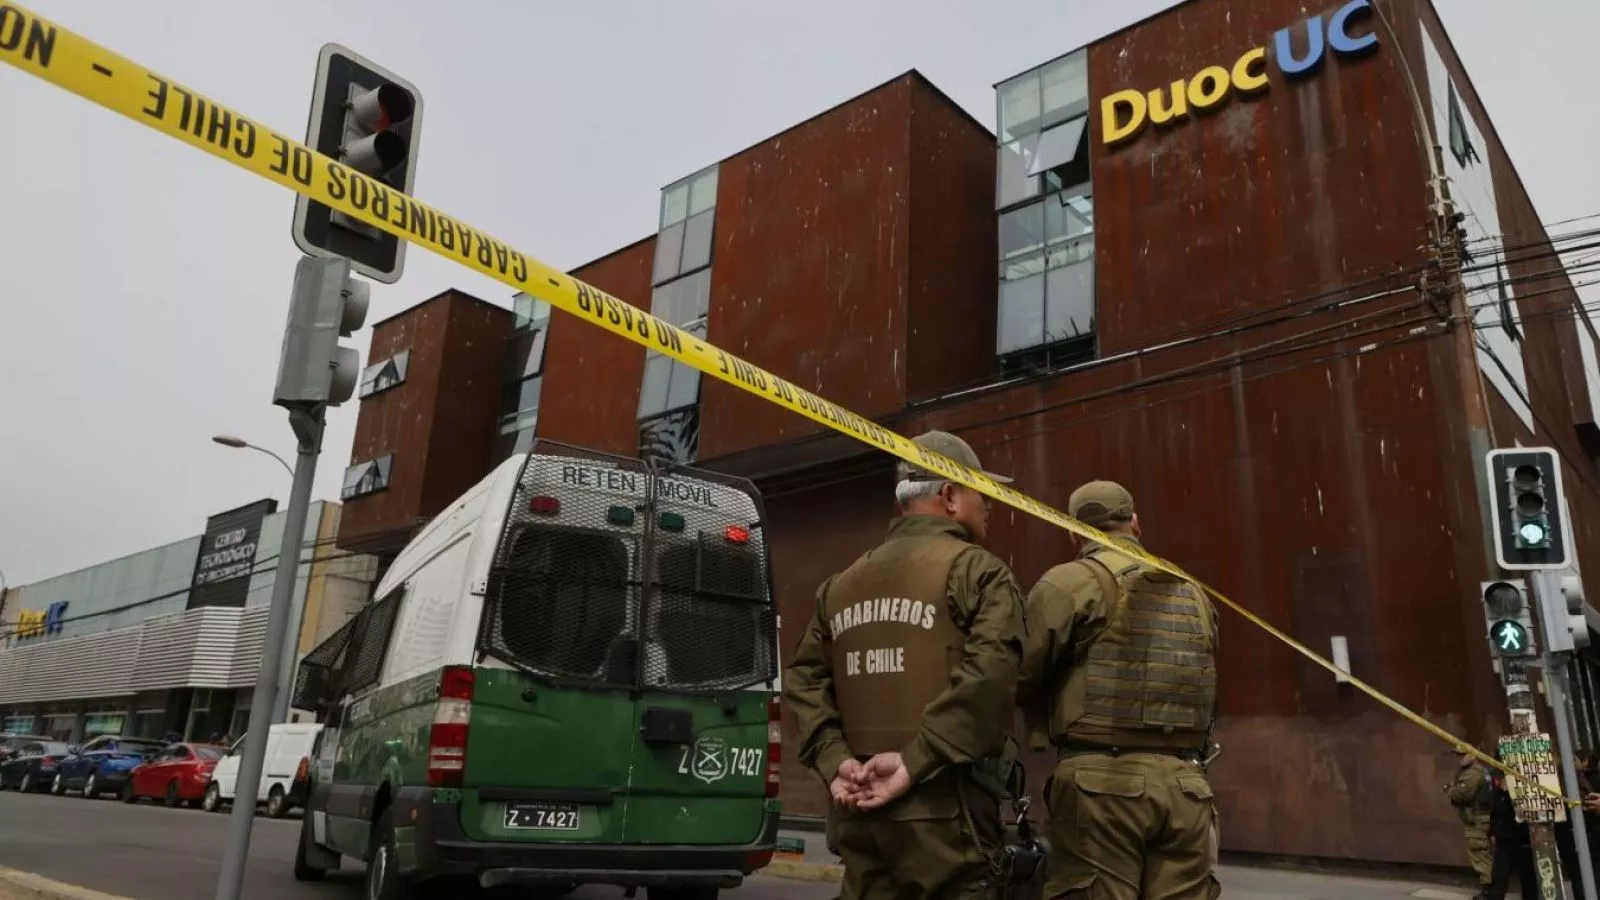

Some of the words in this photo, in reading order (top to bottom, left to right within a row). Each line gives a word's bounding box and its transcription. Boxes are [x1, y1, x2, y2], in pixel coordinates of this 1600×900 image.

[0, 5, 57, 68] NO
[143, 73, 256, 159] CHILE
[269, 132, 313, 186] DE
[327, 161, 528, 283] CARABINEROS
[575, 279, 650, 339] PASAR
[654, 319, 682, 353] NO
[562, 466, 635, 491] RETEN
[658, 479, 718, 508] MOVIL
[829, 597, 936, 641] CARABINEROS
[846, 651, 861, 676] DE
[866, 647, 905, 674] CHILE
[678, 744, 690, 774] Z
[731, 747, 763, 776] 7427
[508, 810, 519, 826] Z
[537, 811, 577, 827] 7427
